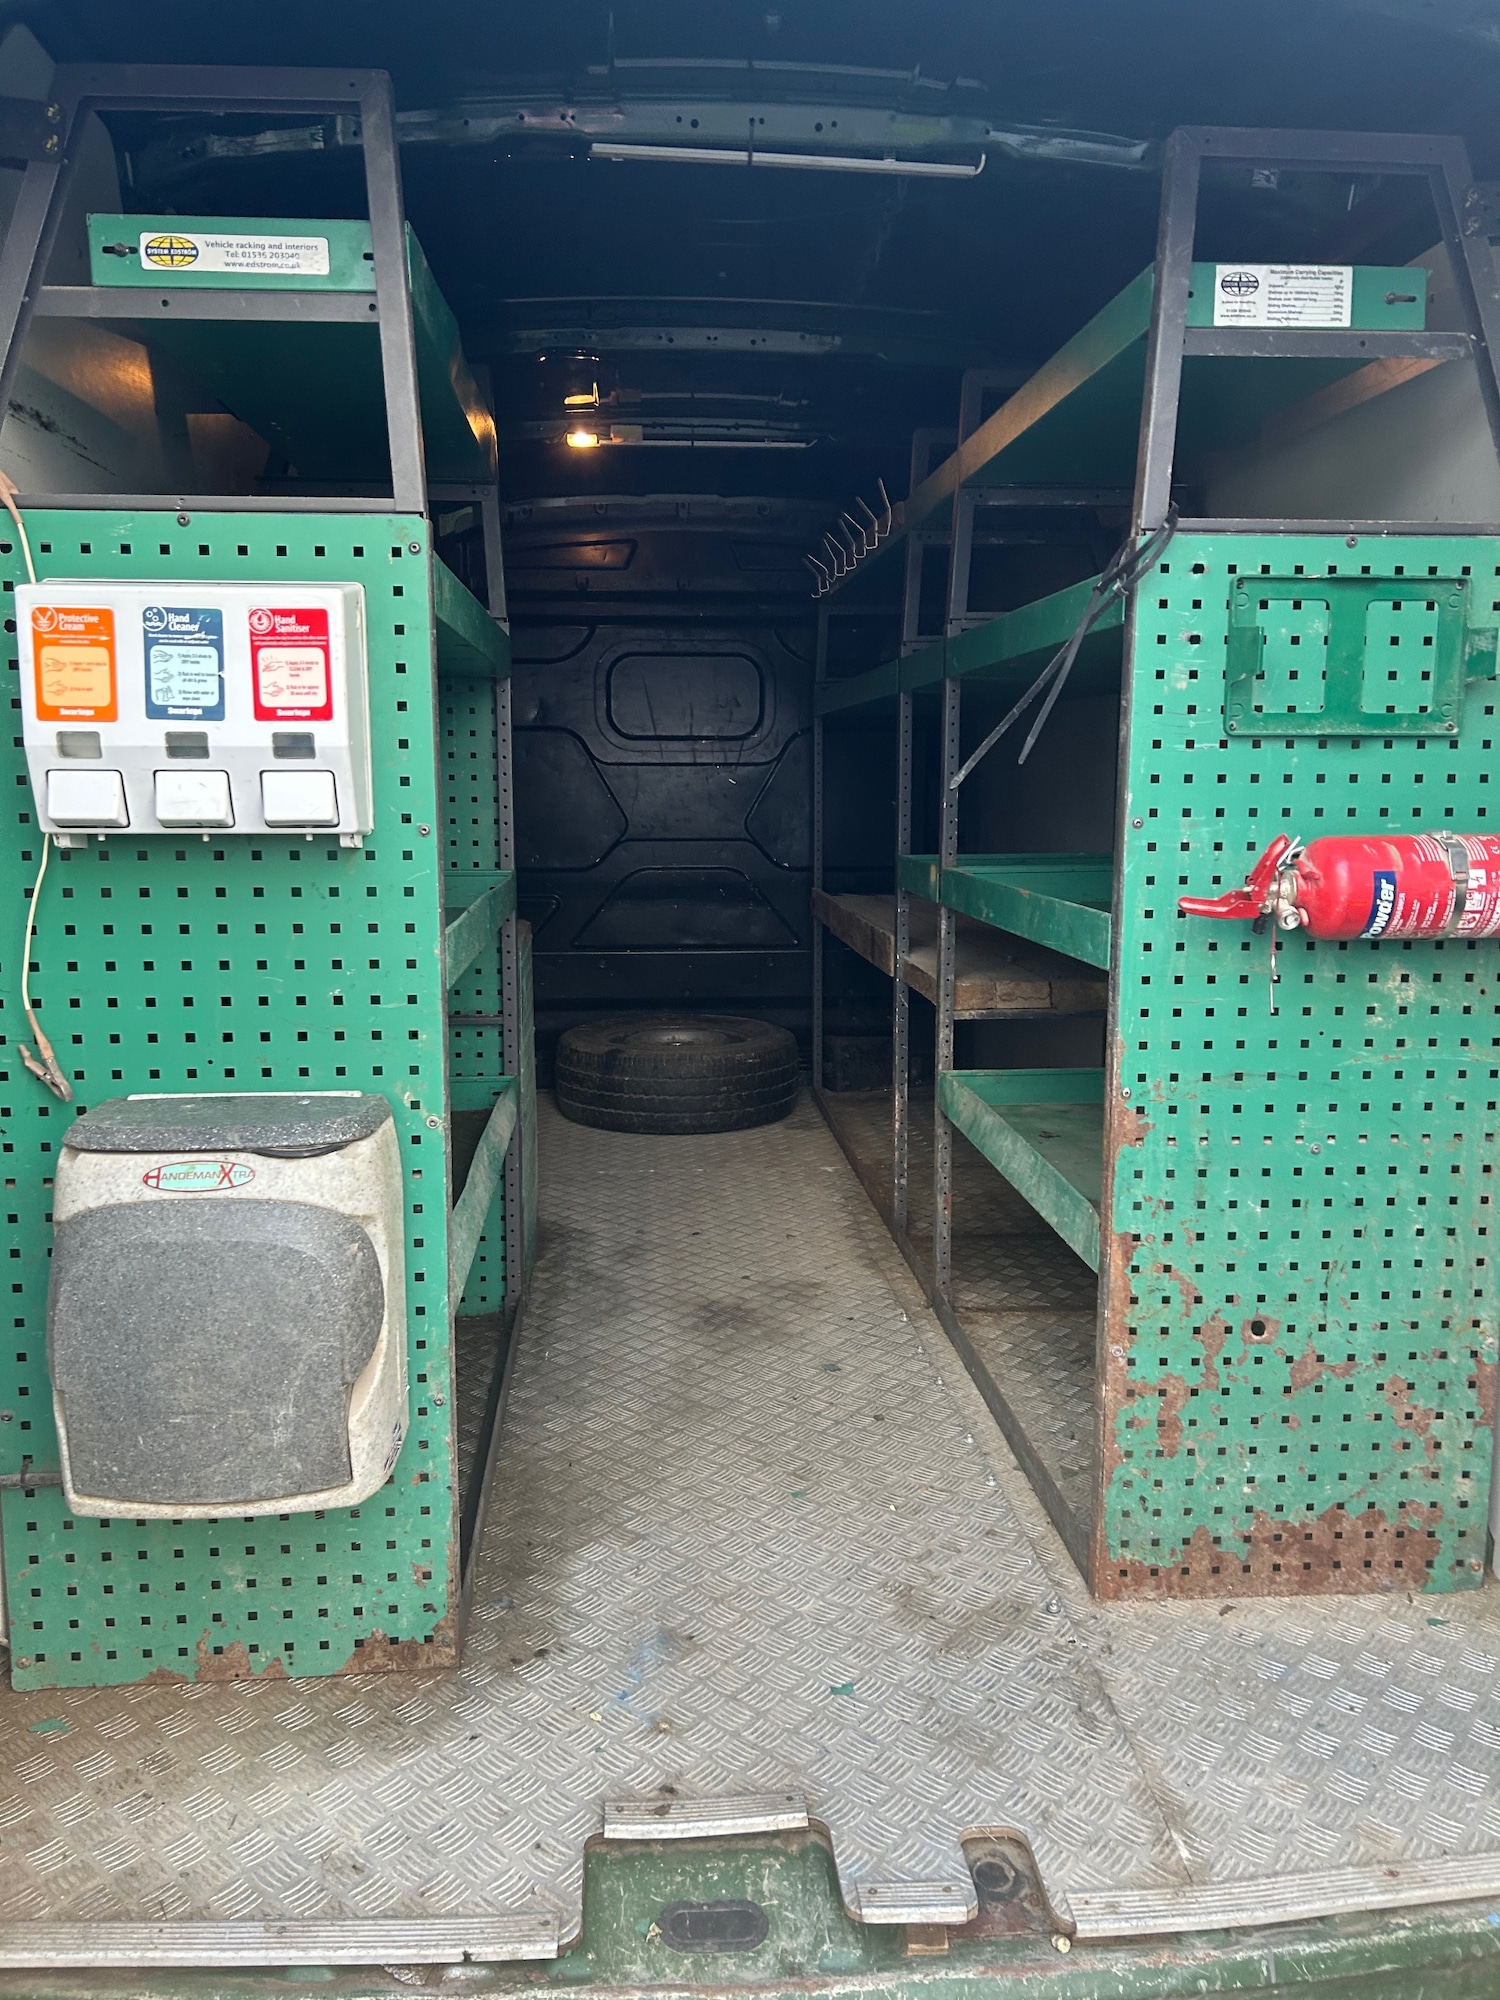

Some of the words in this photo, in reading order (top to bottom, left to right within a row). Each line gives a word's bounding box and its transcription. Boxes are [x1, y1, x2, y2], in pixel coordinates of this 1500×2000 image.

[205, 240, 234, 249] Vehicle
[236, 241, 266, 250] racking
[268, 241, 283, 250] and
[285, 243, 318, 251] interiors
[225, 250, 240, 258] Tel:
[58, 613, 99, 623] Protective
[168, 613, 190, 623] Hand
[274, 614, 296, 624] Hand
[58, 622, 85, 631] Cream
[168, 622, 200, 631] Cleaner
[275, 623, 310, 633] Sanitiser
[1360, 879, 1397, 938] Powder
